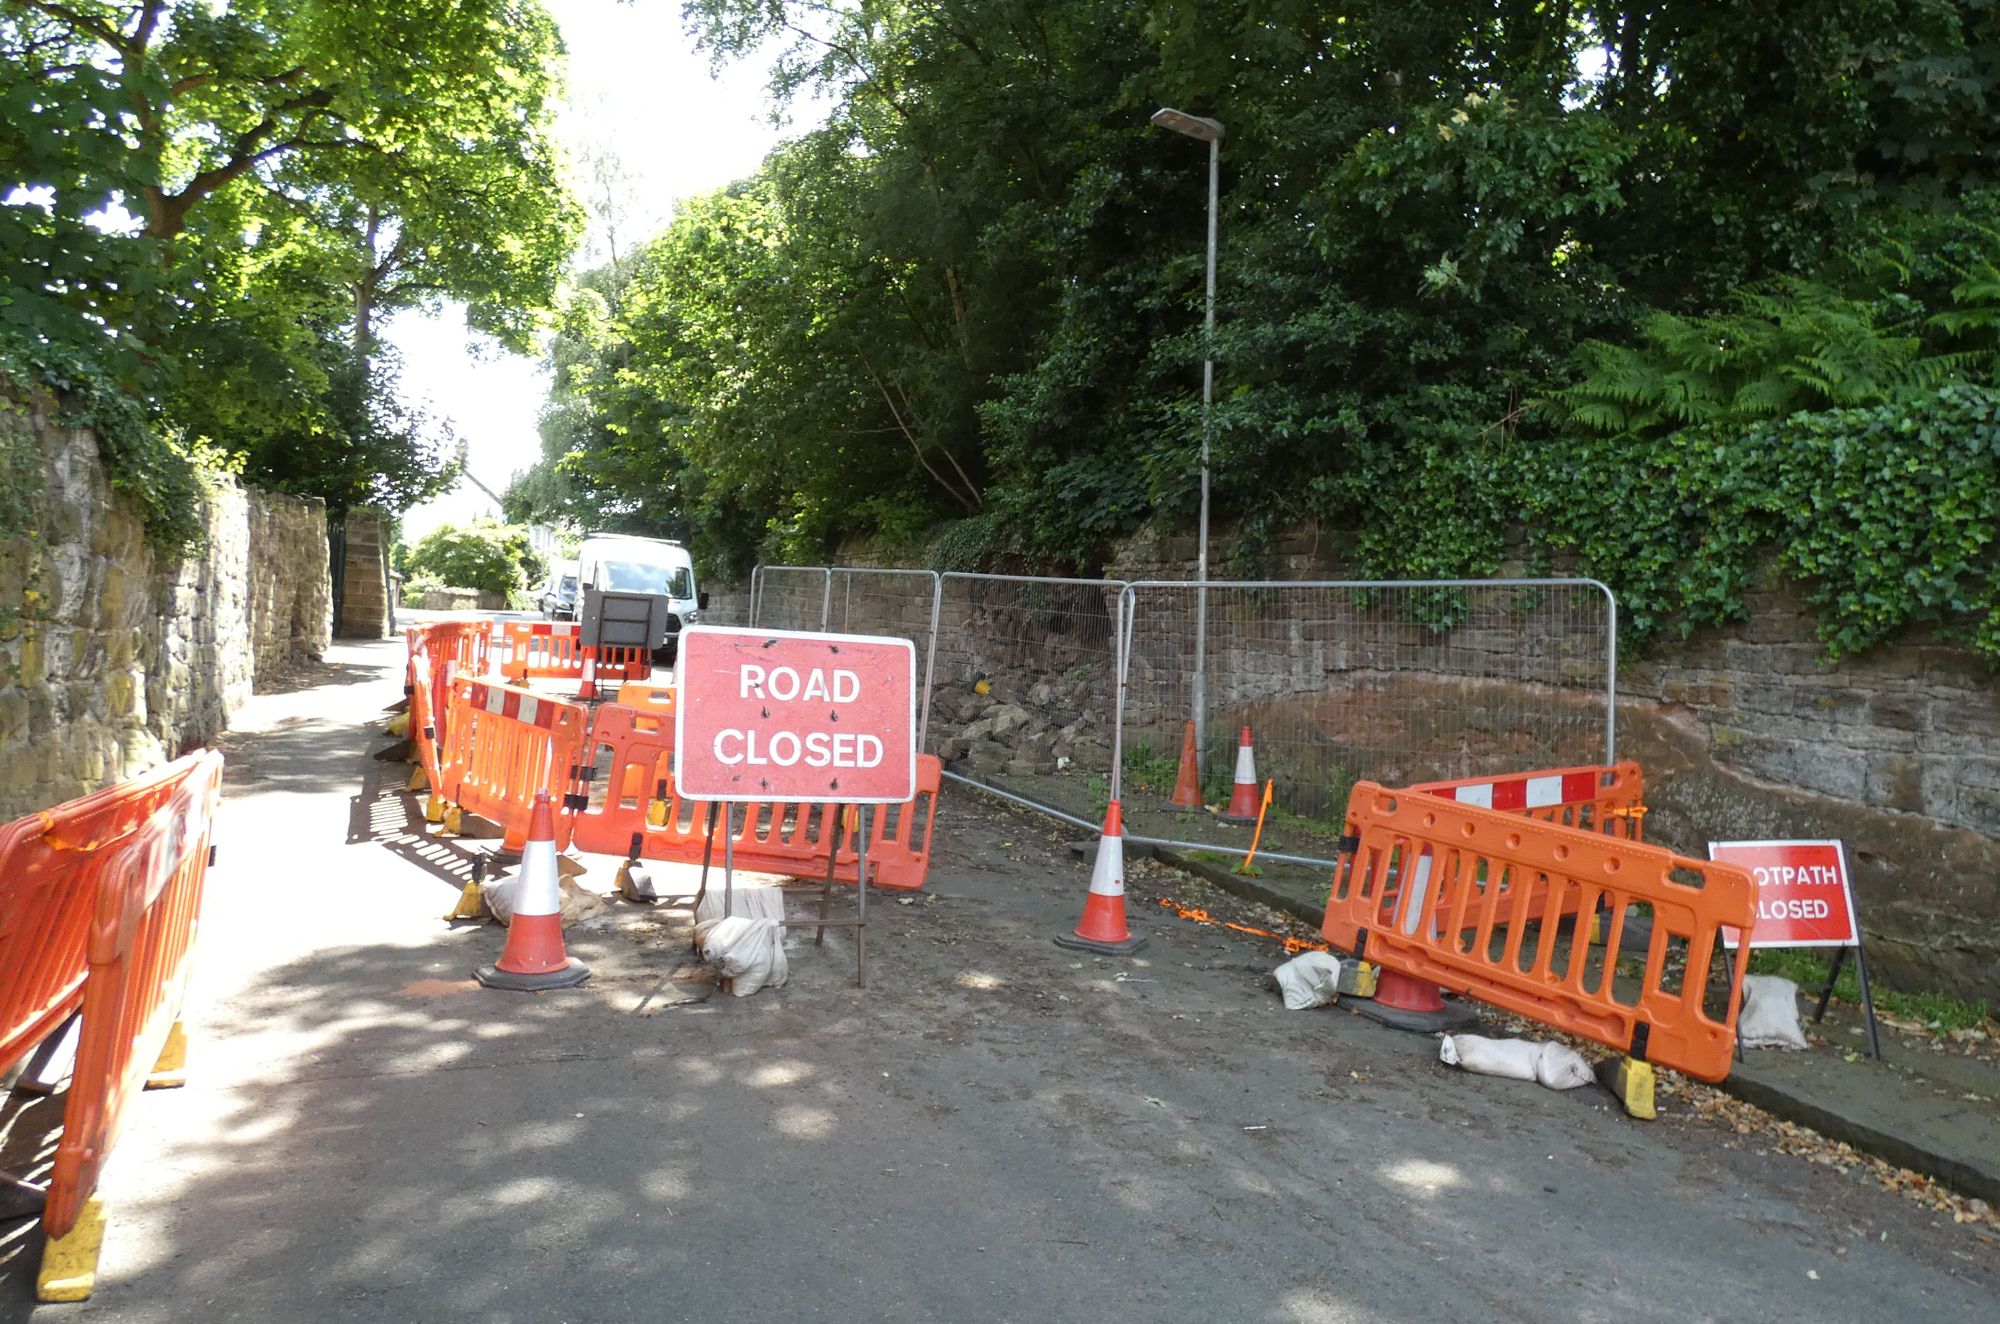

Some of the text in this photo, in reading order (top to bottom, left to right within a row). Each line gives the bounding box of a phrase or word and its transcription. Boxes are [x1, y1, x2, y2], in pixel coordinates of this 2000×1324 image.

[740, 664, 860, 703] ROAD
[713, 728, 884, 768] CLOSED
[1753, 866, 1838, 886] OTPATH
[1756, 900, 1828, 919] LOSED
